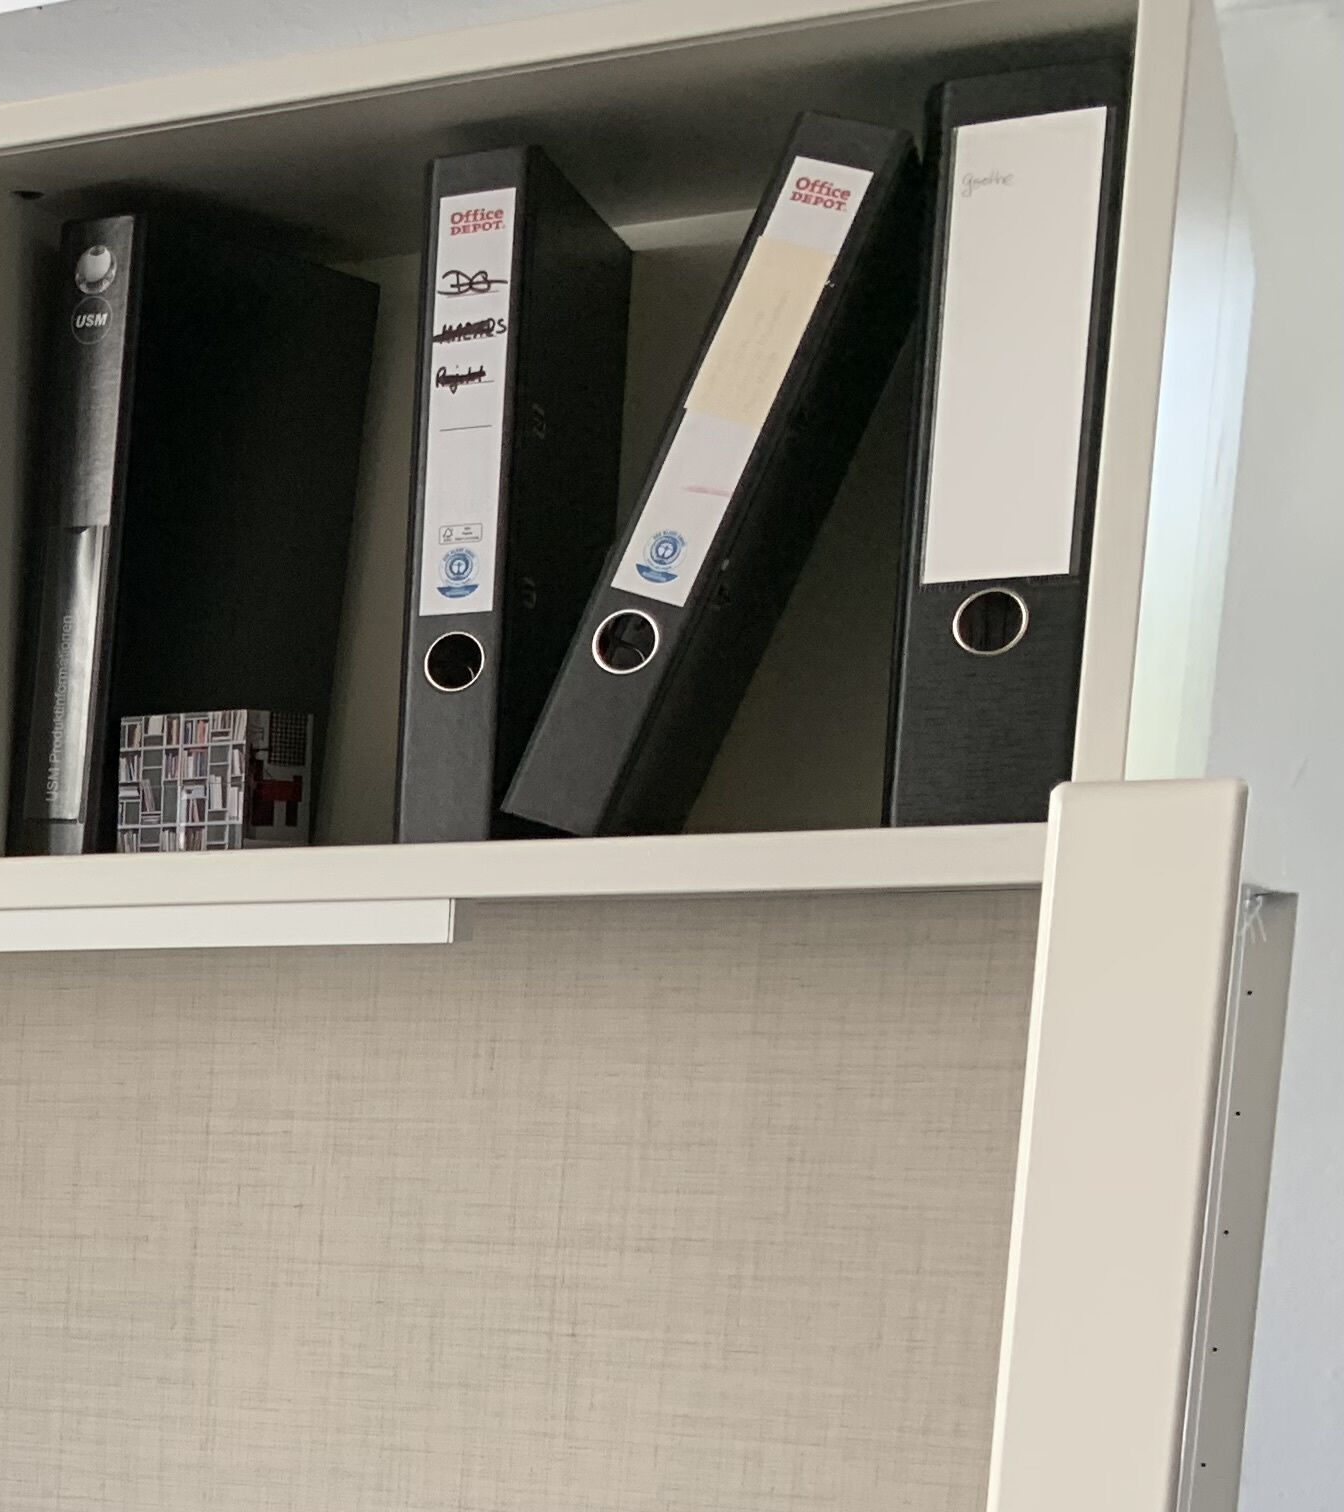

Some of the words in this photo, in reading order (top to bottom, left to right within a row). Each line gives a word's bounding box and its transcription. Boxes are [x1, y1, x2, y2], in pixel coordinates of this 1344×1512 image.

[796, 177, 851, 200] Office
[790, 192, 846, 211] DEPOT
[450, 209, 503, 225] Office
[450, 220, 503, 236] DEPOT
[76, 312, 108, 329] USM
[46, 767, 61, 802] USM
